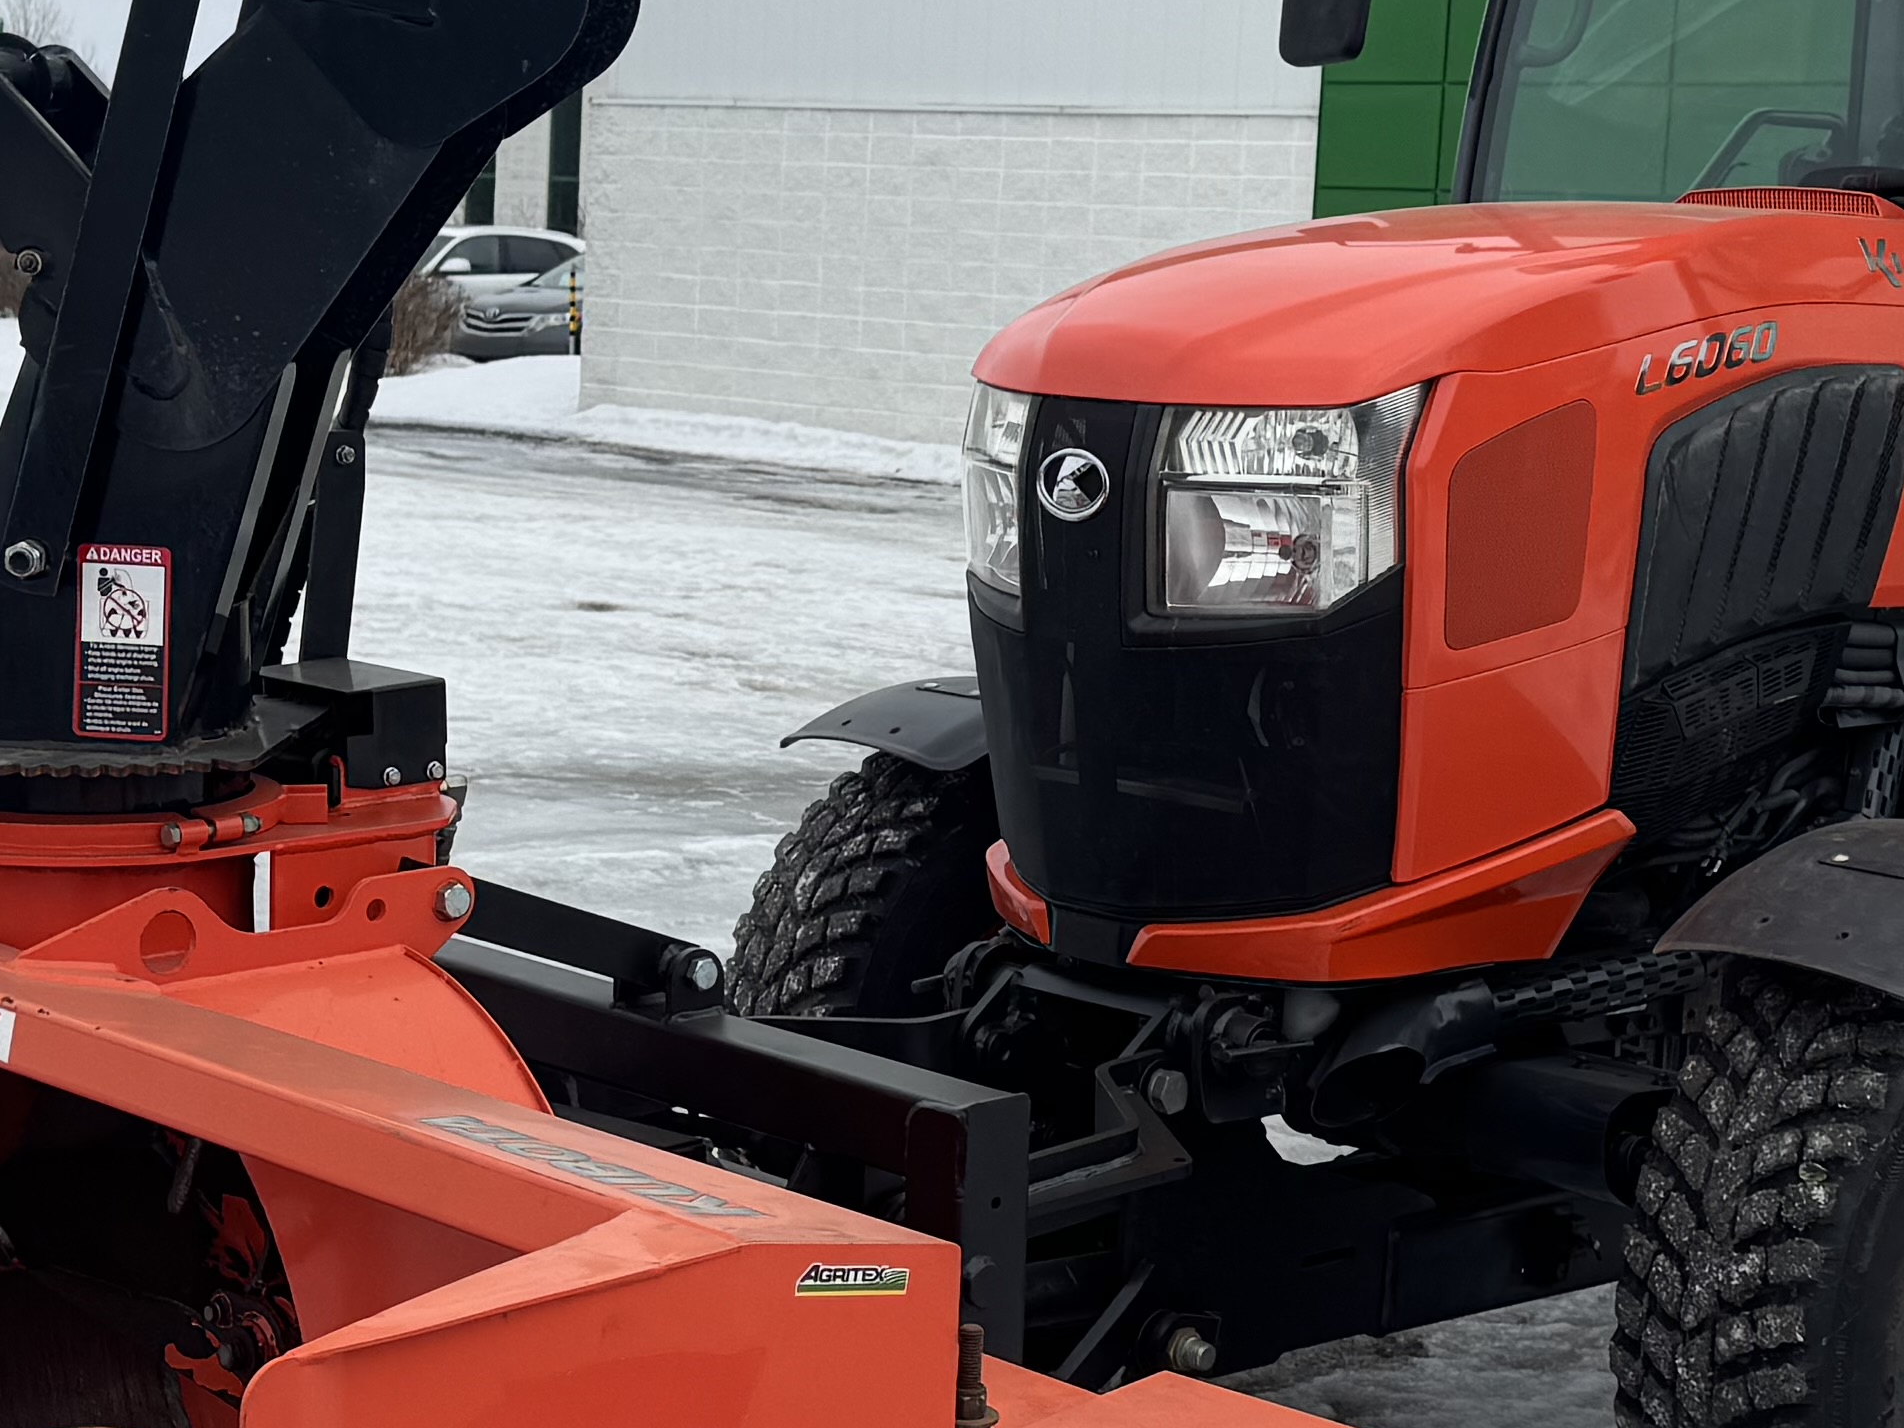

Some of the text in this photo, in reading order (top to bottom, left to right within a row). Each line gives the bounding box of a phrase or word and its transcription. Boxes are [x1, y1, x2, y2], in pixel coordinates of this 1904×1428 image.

[1634, 320, 1779, 396] L6060
[100, 547, 162, 564] DANGER
[418, 1114, 774, 1219] KUBOTA
[799, 1262, 890, 1285] AGRITEX
